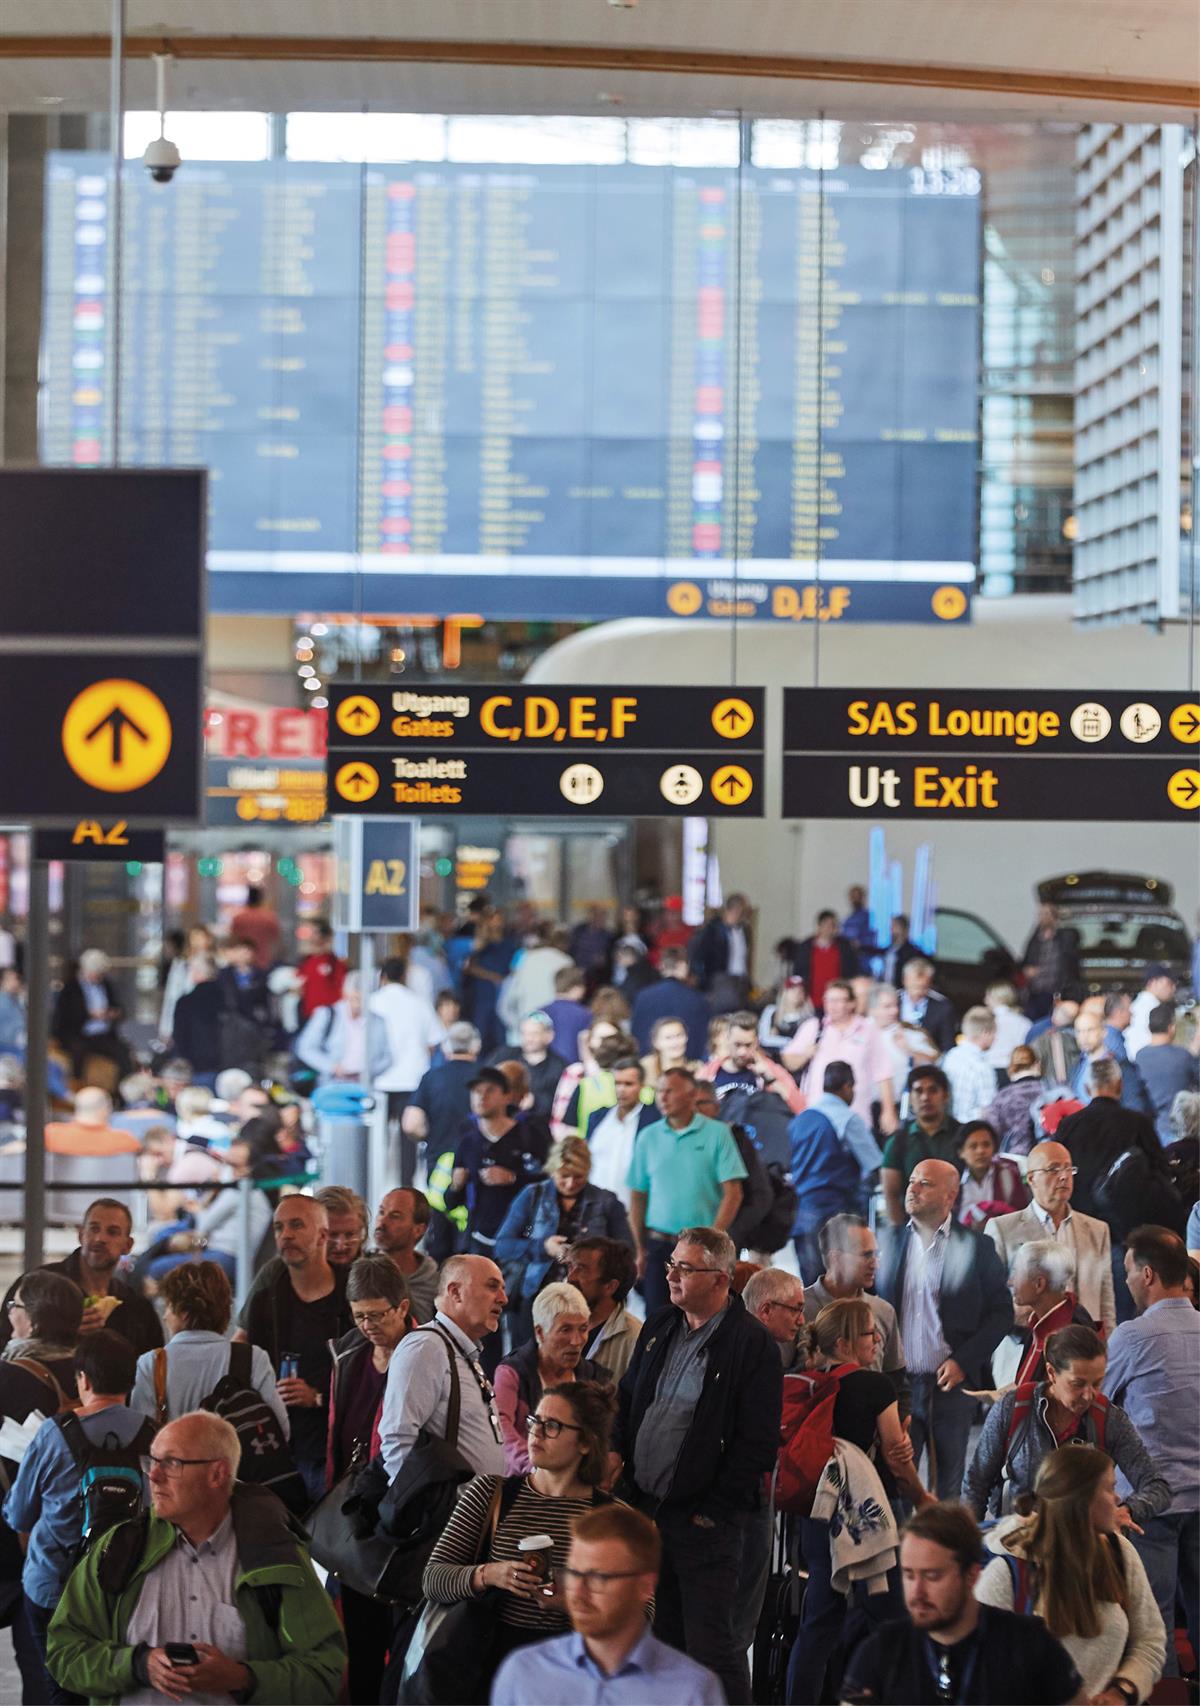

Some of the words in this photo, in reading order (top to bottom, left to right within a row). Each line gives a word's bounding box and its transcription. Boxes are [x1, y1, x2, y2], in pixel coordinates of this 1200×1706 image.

[391, 715, 455, 737] Gates
[479, 695, 638, 742] C,D,E,F
[847, 701, 918, 736] SAS
[928, 702, 1060, 746] Lounge
[391, 757, 468, 779] Toalett
[848, 766, 901, 808] Ut
[914, 765, 999, 808] Exit
[391, 782, 463, 804] Toilets
[365, 858, 406, 896] A2
